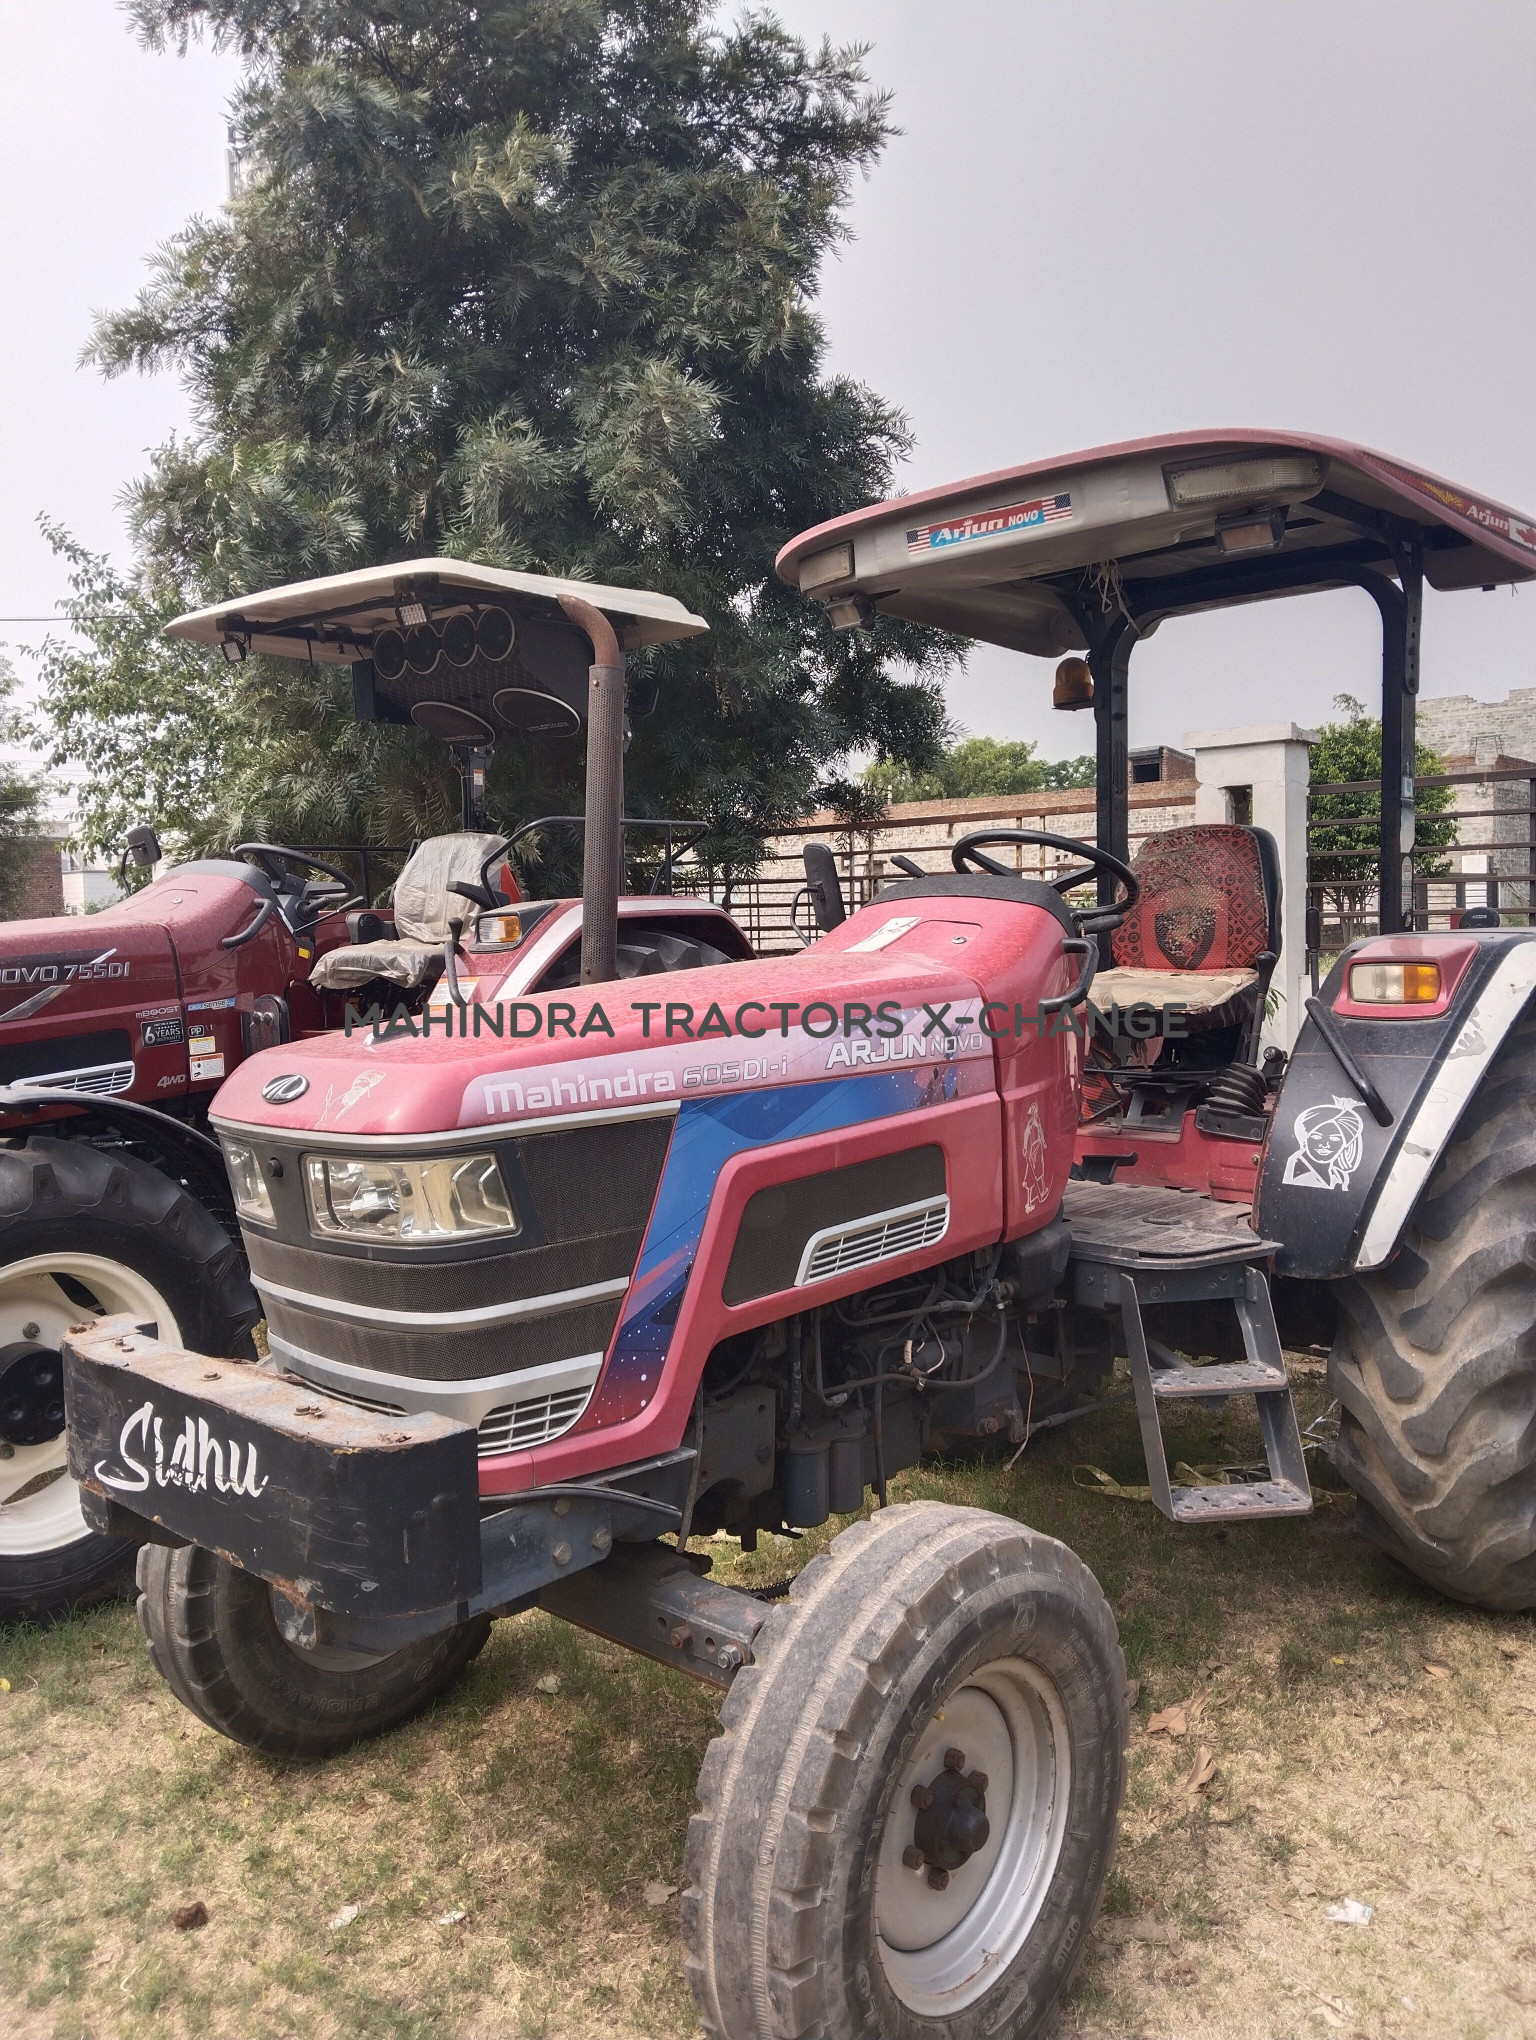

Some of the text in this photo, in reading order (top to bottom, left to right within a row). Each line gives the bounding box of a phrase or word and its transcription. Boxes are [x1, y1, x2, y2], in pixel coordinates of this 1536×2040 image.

[935, 509, 1038, 544] Arjun NOVO
[1466, 505, 1509, 531] Arjun
[0, 962, 131, 984] OVO 755DI
[144, 1026, 156, 1045] 6
[155, 1027, 181, 1038] YEARS
[157, 1074, 186, 1088] 4WD
[483, 1068, 676, 1115] Mahindra
[824, 1032, 927, 1070] ARJUN
[930, 1032, 984, 1057] NOVO
[1056, 1919, 1082, 1969] apollo
